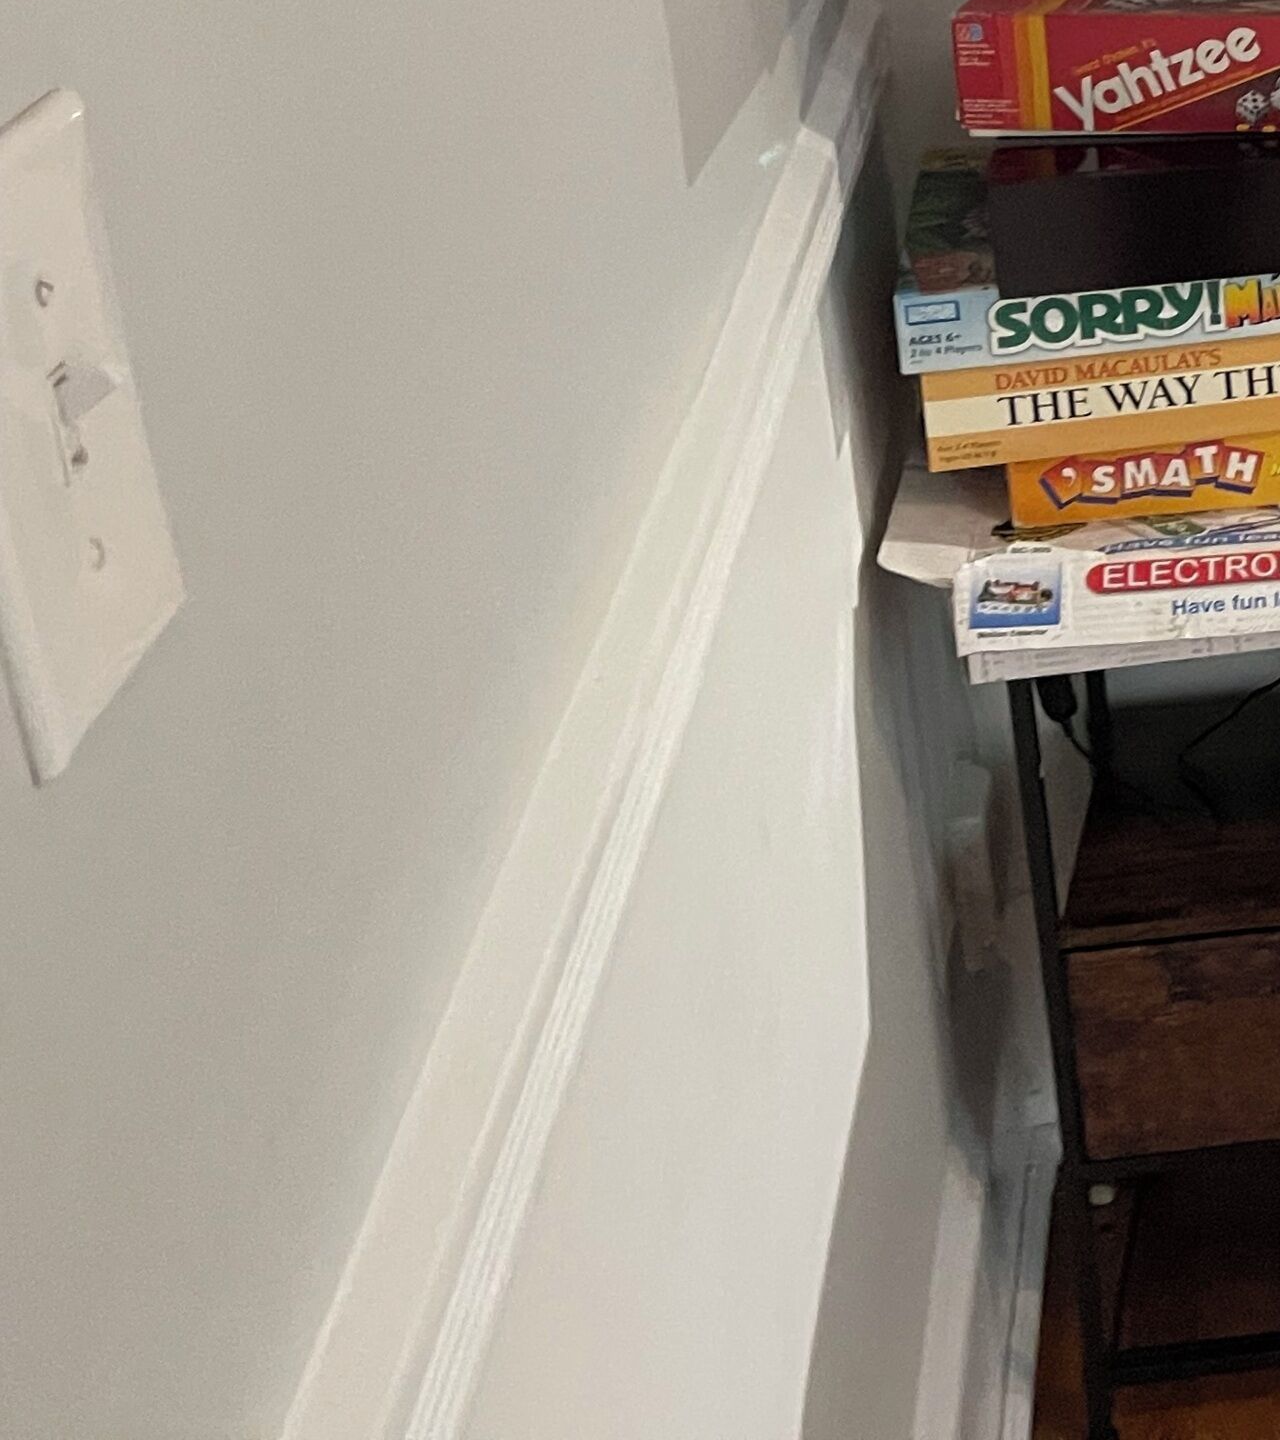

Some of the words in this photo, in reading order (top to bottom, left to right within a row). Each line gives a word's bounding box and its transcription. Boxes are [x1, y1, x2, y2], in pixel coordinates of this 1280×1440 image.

[1054, 26, 1261, 132] Yahtzee
[994, 279, 1221, 349] SORRY!
[994, 364, 1068, 392] DAVID
[1075, 348, 1222, 381] MACAULAY'S
[996, 387, 1093, 427] THE
[1101, 373, 1201, 412] WAY
[1172, 597, 1226, 616] Have
[1231, 594, 1267, 611] fun
